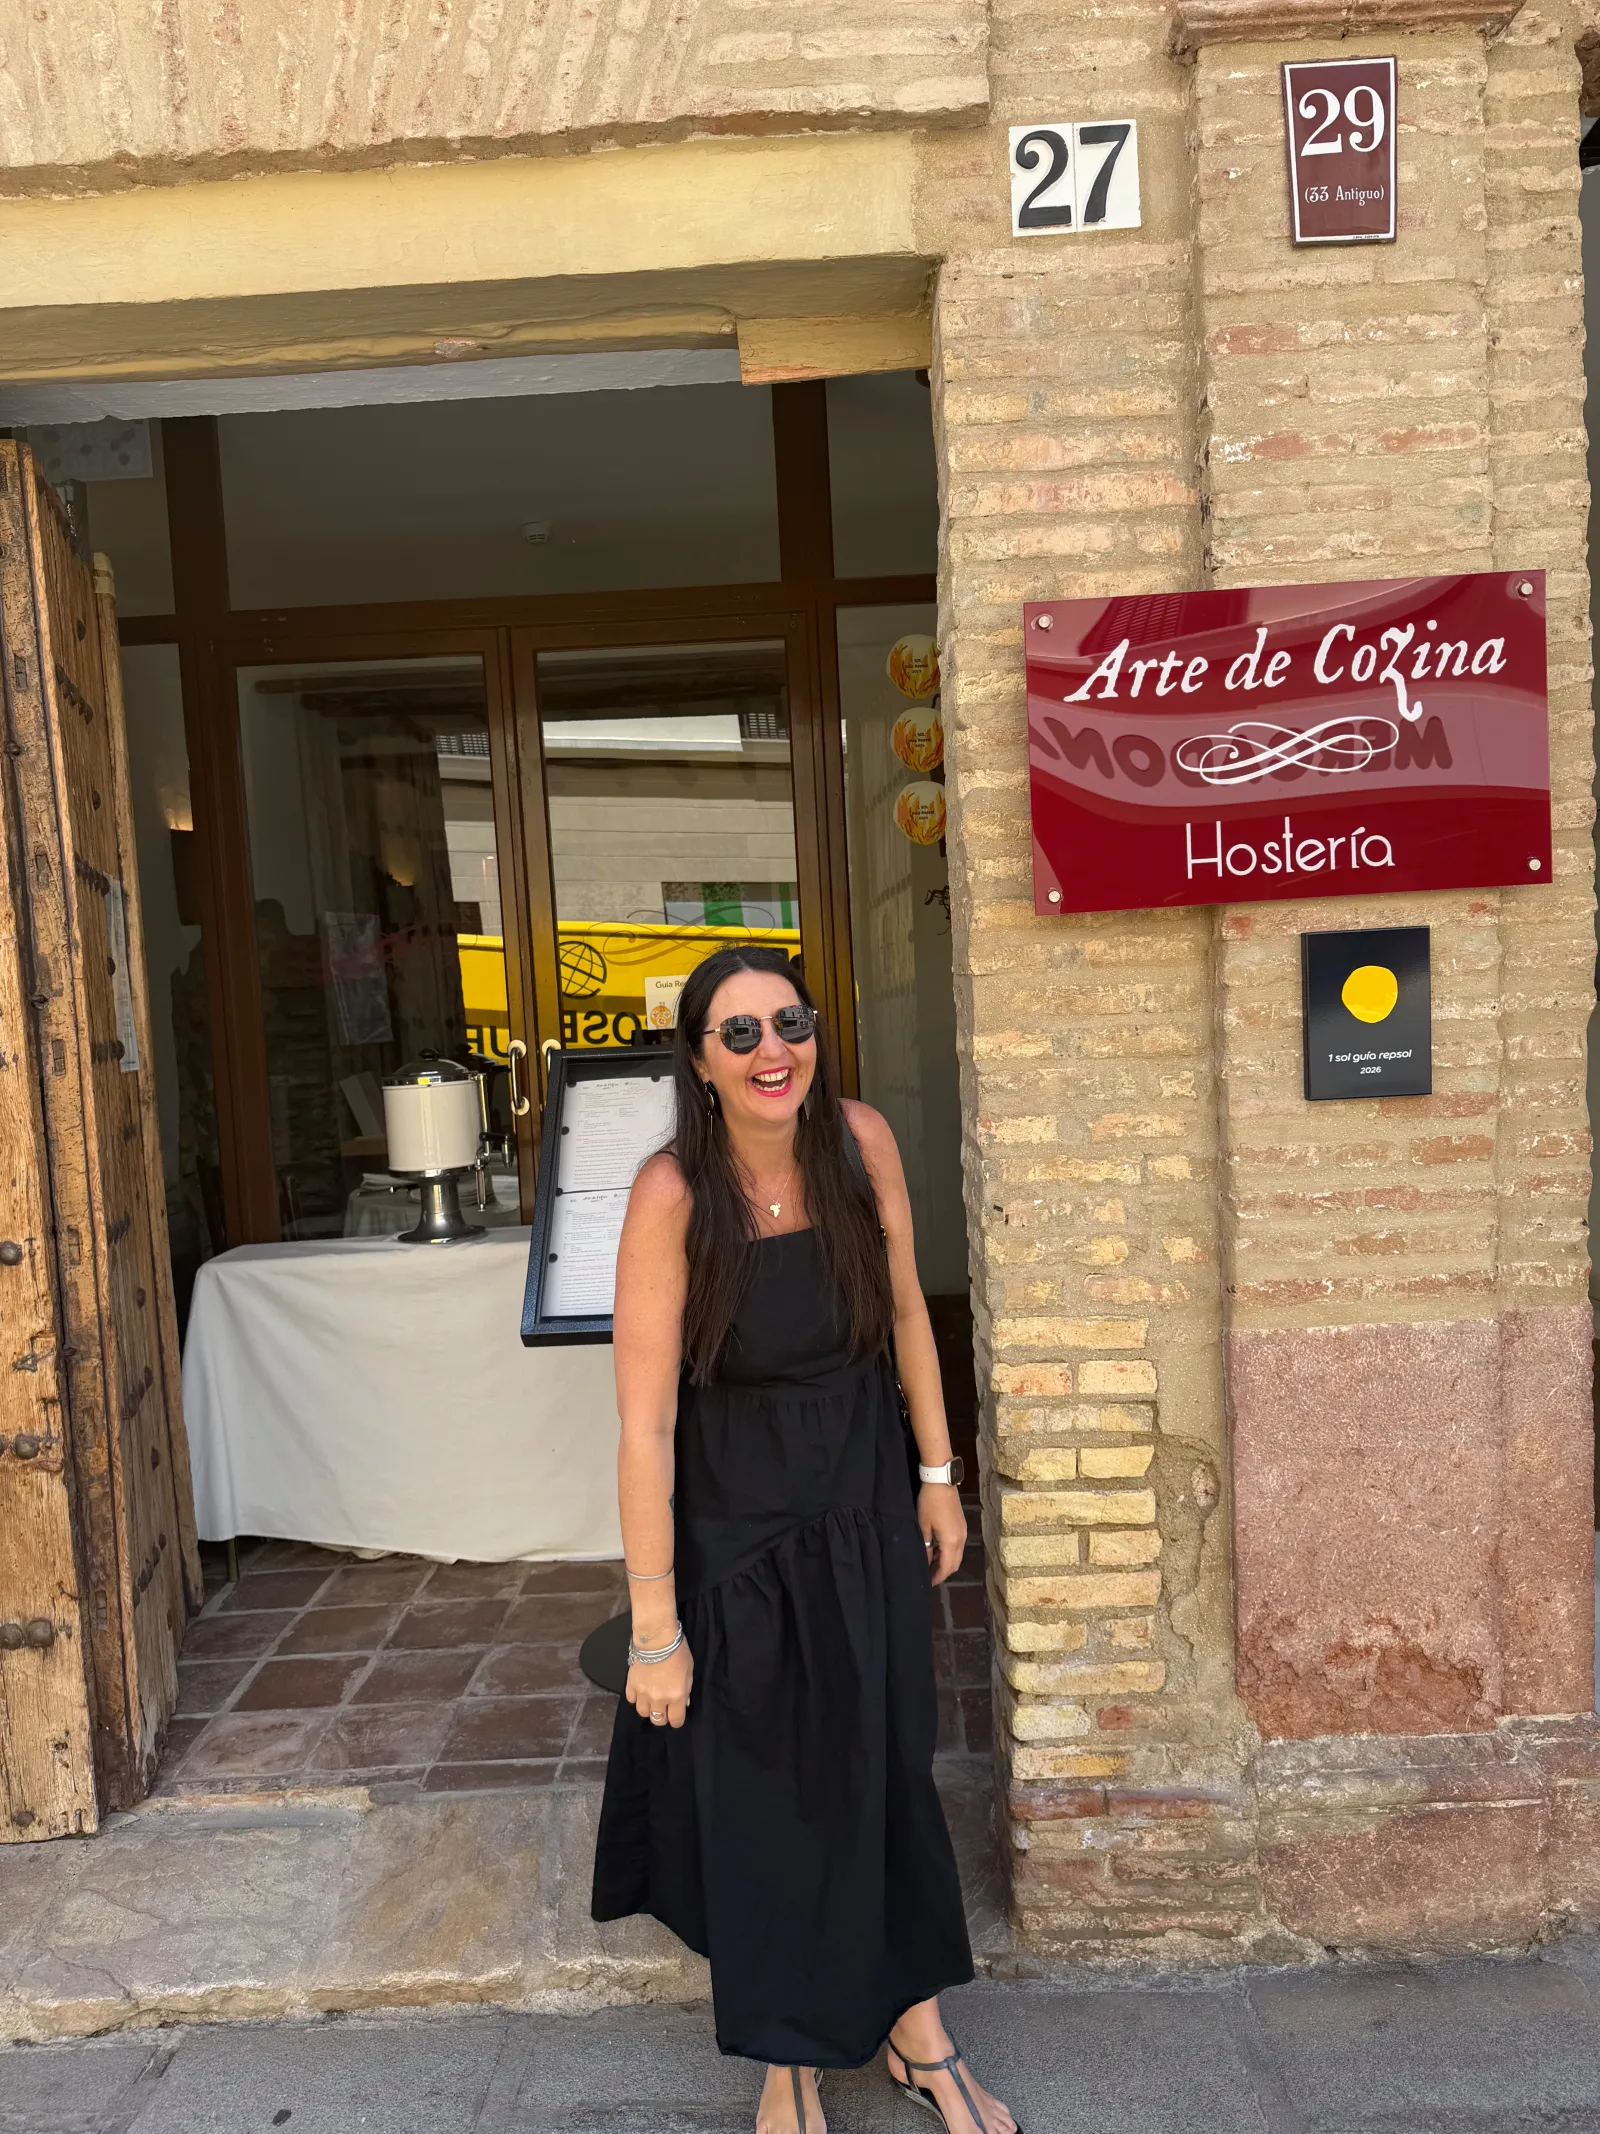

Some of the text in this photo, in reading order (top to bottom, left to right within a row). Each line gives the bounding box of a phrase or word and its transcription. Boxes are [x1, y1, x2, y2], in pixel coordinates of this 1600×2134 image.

[1298, 85, 1385, 157] 29
[1015, 124, 1131, 229] 27
[1304, 184, 1385, 207] (33 Antiguo)
[1063, 638, 1209, 703] Arte
[1224, 627, 1292, 690] de
[1186, 816, 1396, 879] Hostería
[1328, 1048, 1413, 1064] 1 sol guía repsol
[1359, 1065, 1382, 1075] 2026
